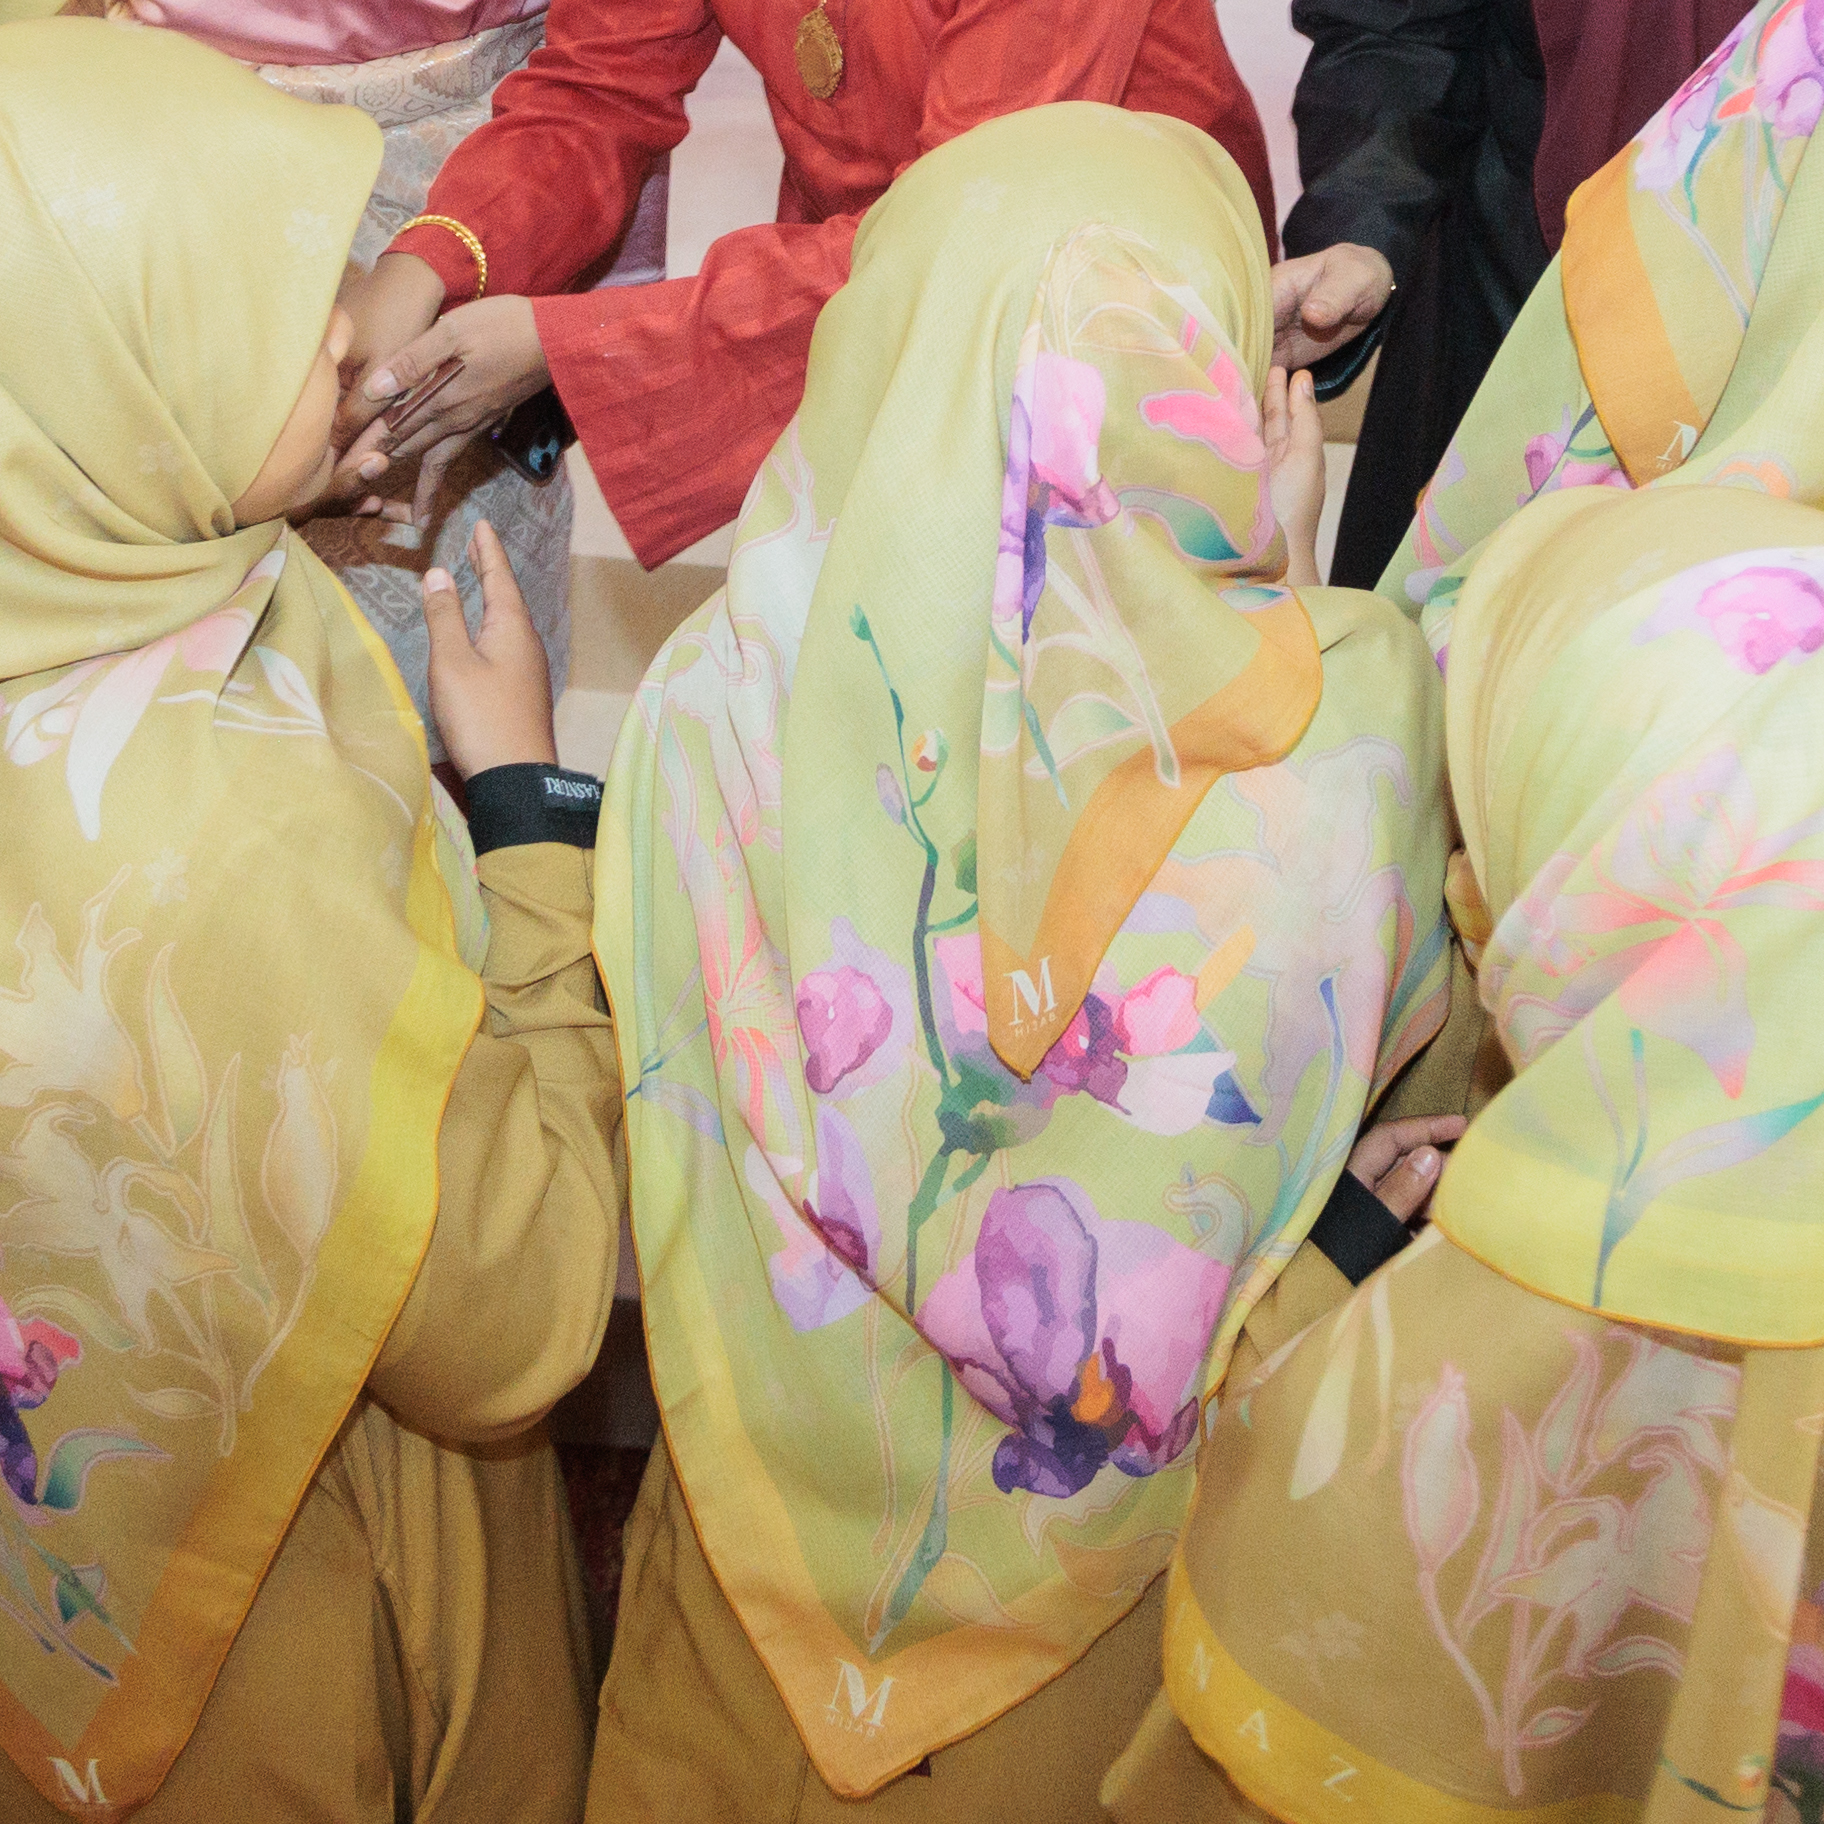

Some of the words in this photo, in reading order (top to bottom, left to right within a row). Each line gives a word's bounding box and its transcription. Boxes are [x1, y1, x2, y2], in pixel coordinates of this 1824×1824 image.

[1004, 955, 1059, 1027] M
[824, 1657, 897, 1728] M
[46, 1756, 108, 1804] M
